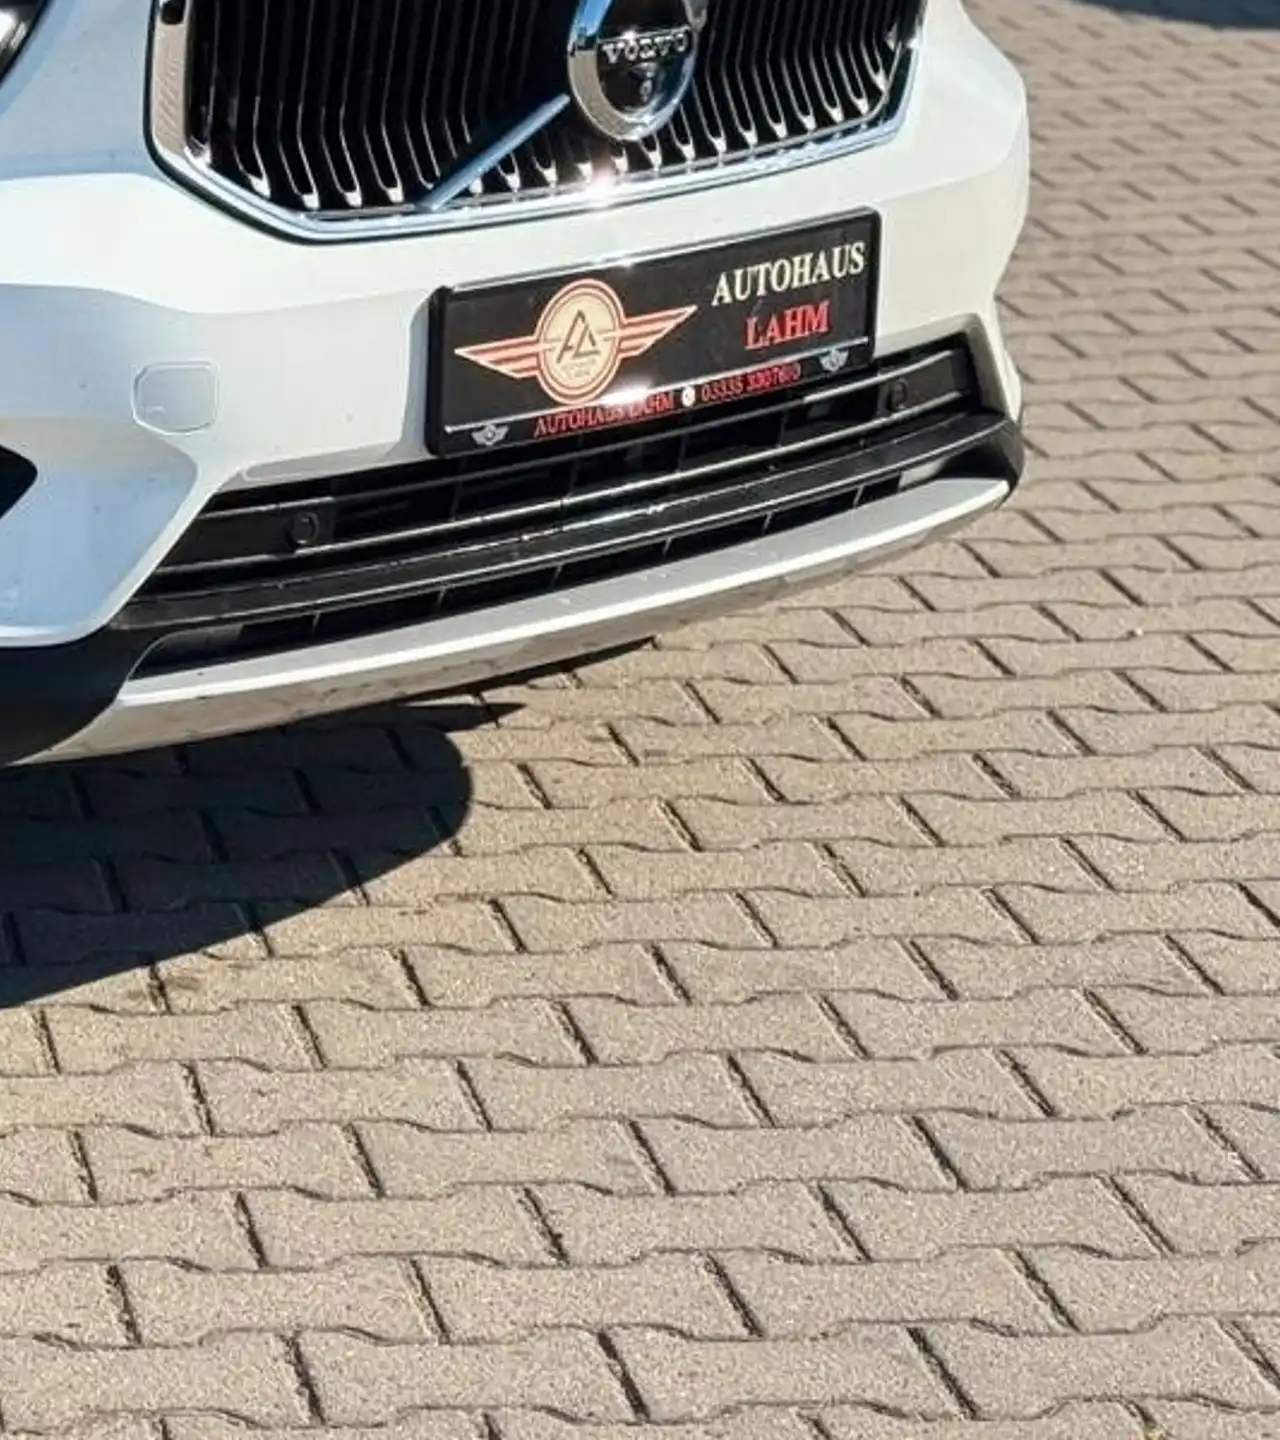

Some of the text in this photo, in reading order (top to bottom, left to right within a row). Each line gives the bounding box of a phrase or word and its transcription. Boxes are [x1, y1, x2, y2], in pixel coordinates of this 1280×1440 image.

[602, 32, 689, 64] VOLVO
[711, 242, 866, 306] AUTOHAUS
[744, 299, 831, 350] LAHM
